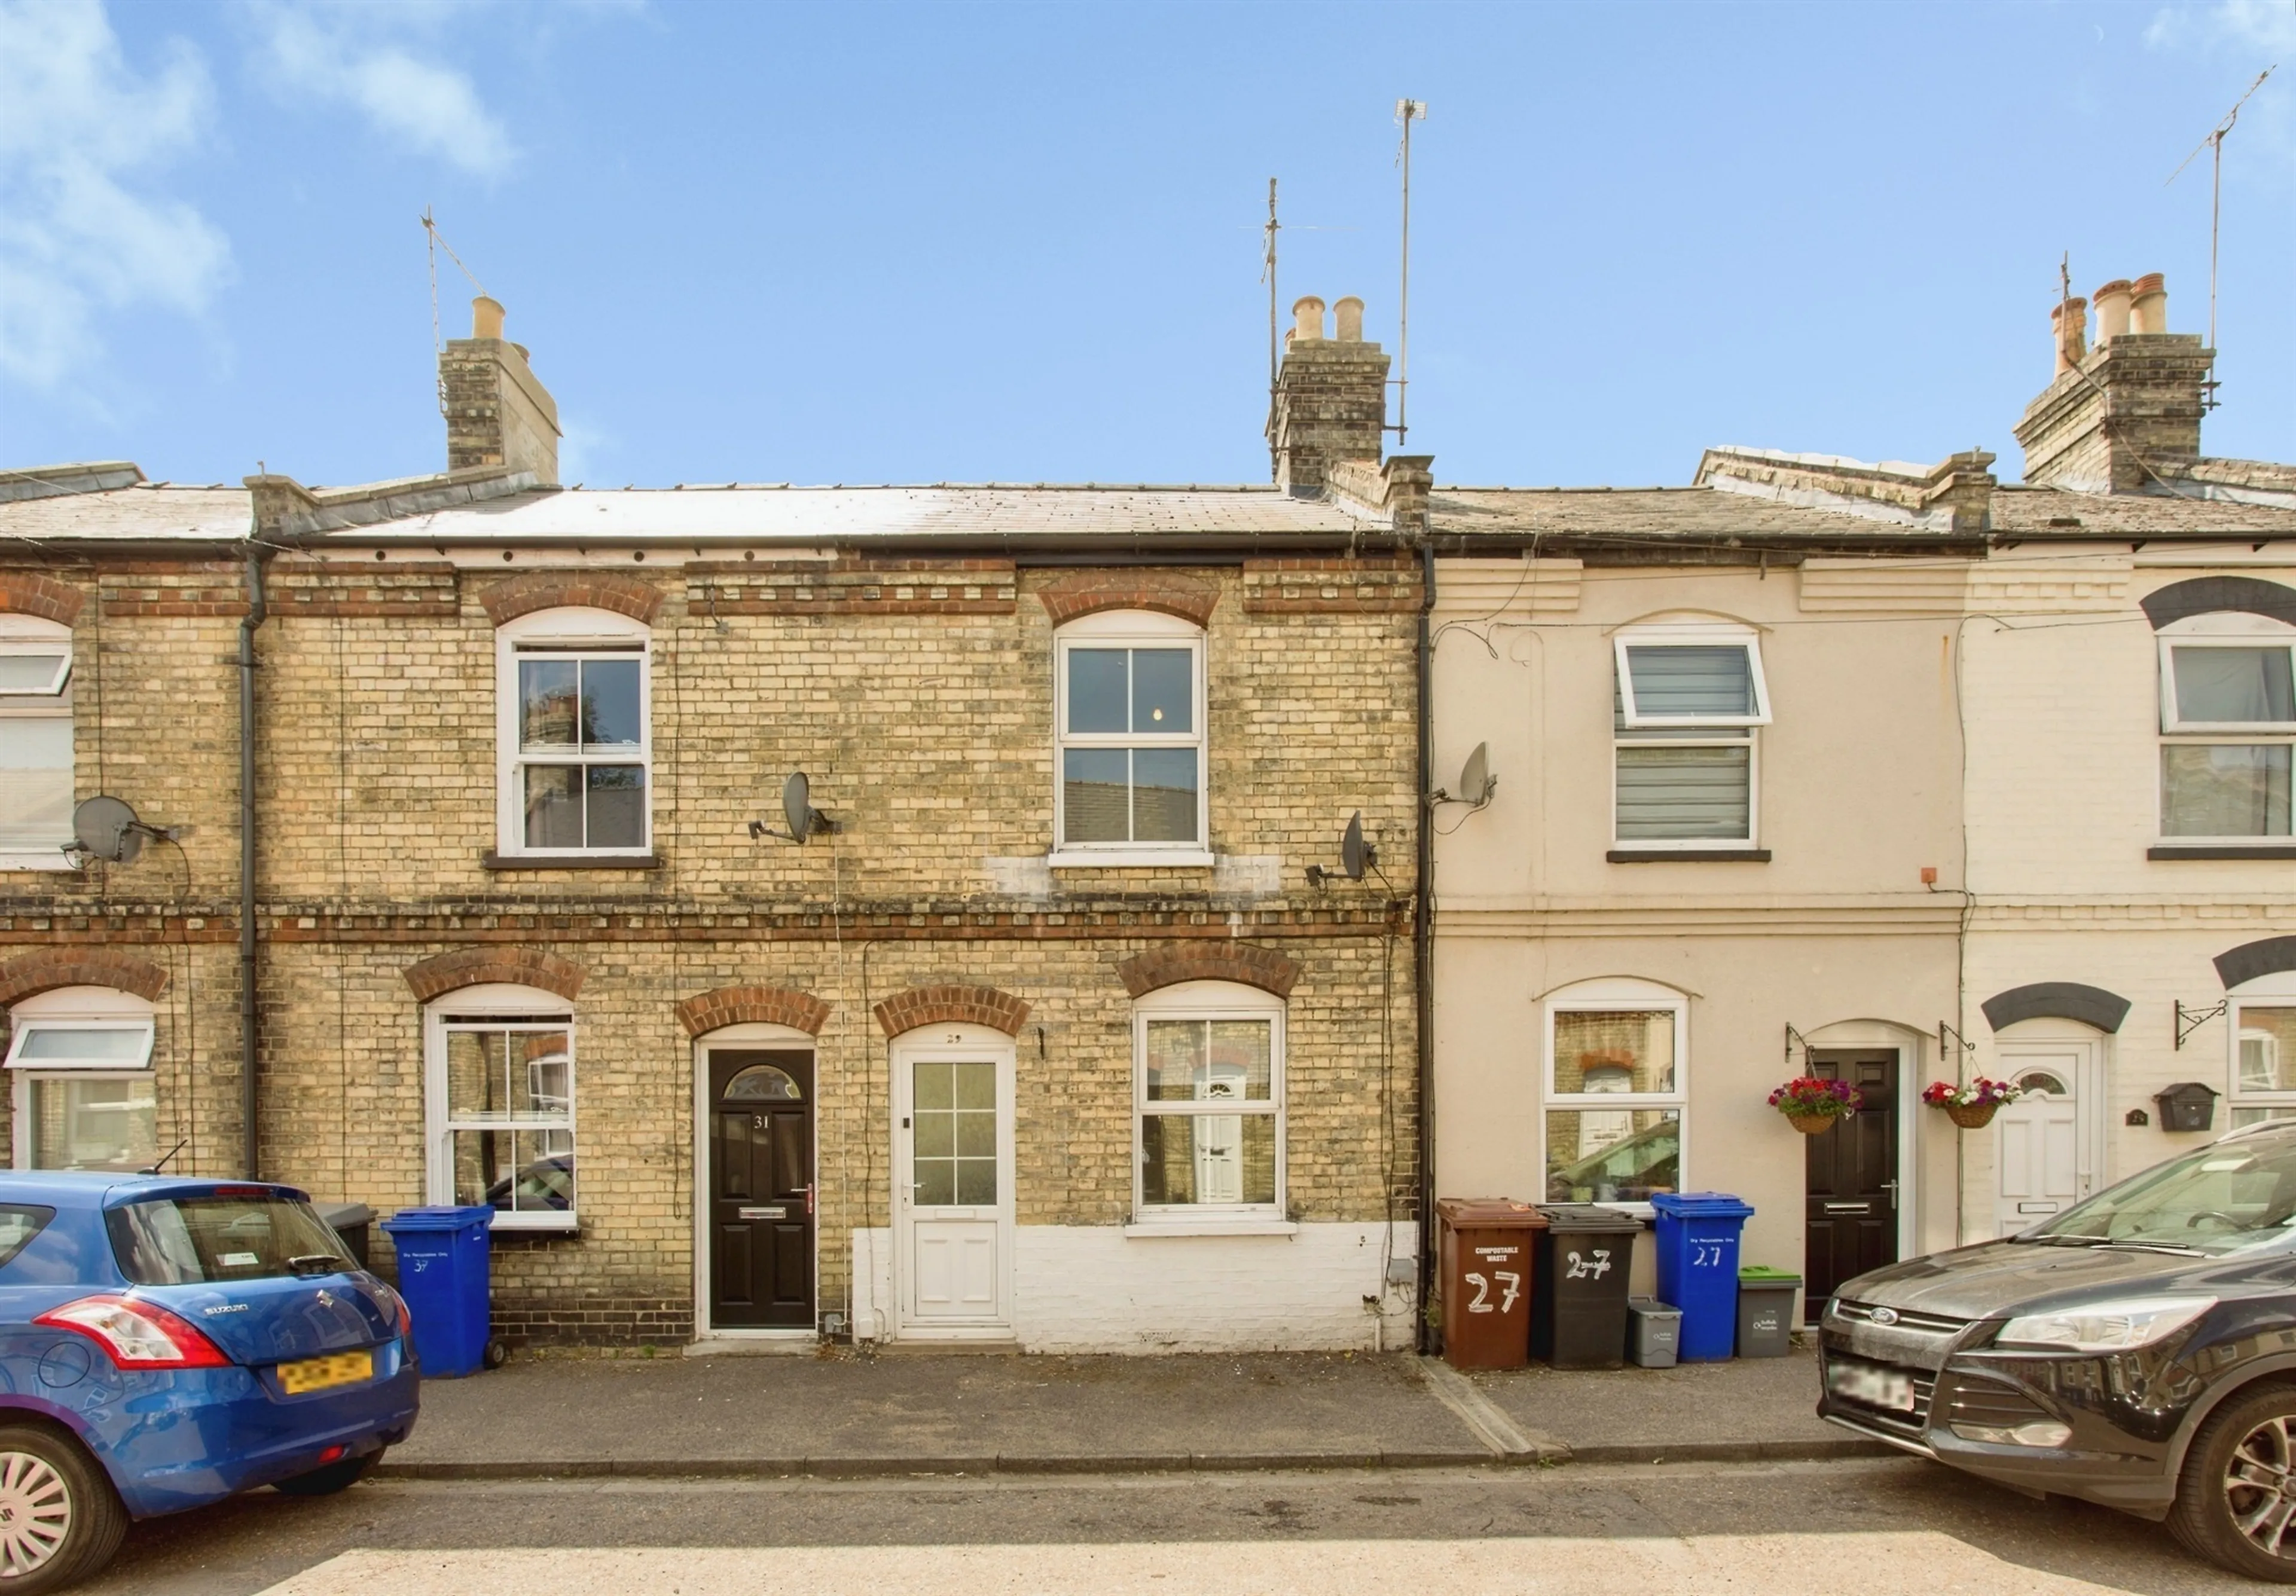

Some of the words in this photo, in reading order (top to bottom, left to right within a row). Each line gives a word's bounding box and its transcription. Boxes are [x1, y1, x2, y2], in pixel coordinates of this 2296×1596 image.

[947, 1034, 961, 1044] 29
[754, 1115, 768, 1129] 31
[1566, 1250, 1610, 1279] 27
[1693, 1246, 1720, 1267] 27
[1465, 1271, 1520, 1313] 27
[204, 1304, 249, 1315] SUZUKI
